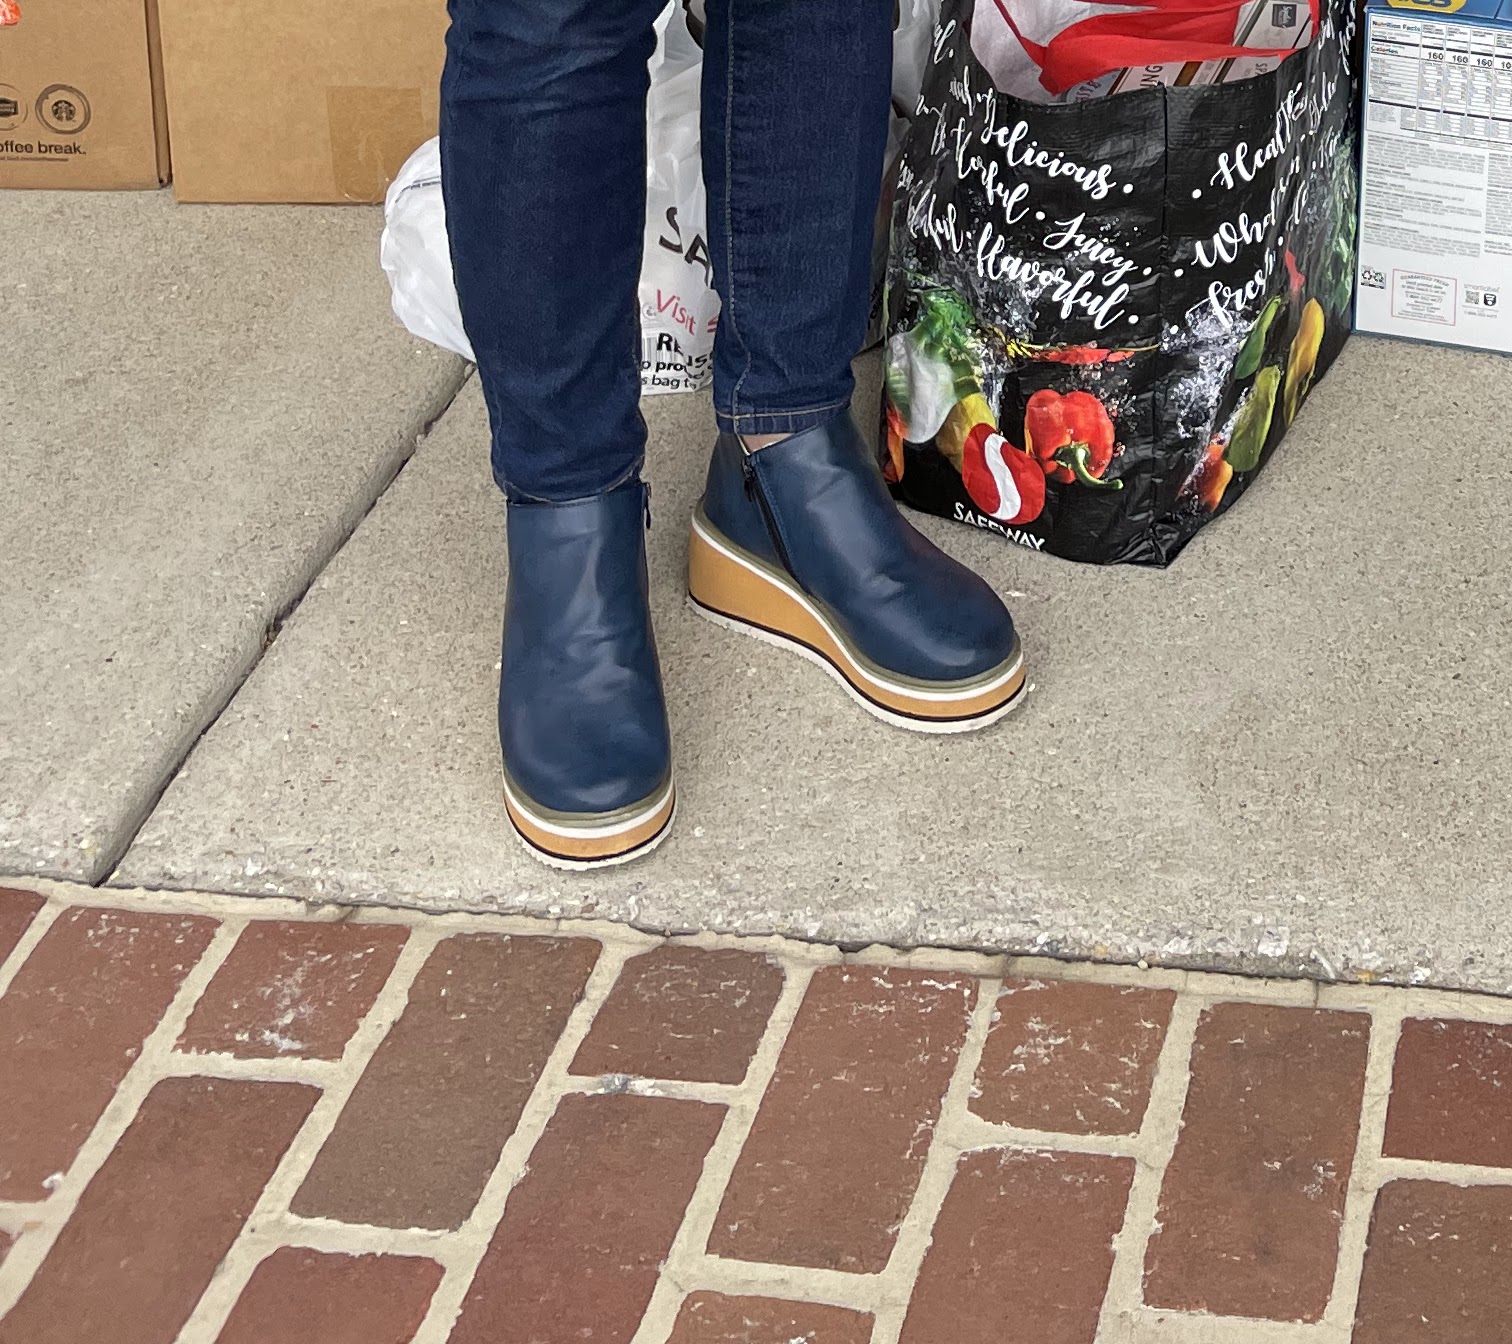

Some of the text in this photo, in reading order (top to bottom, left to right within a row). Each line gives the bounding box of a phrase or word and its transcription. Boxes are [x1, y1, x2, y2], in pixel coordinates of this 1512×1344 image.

[37, 141, 87, 155] break.
[656, 289, 697, 336] Visit
[652, 374, 681, 390] bag
